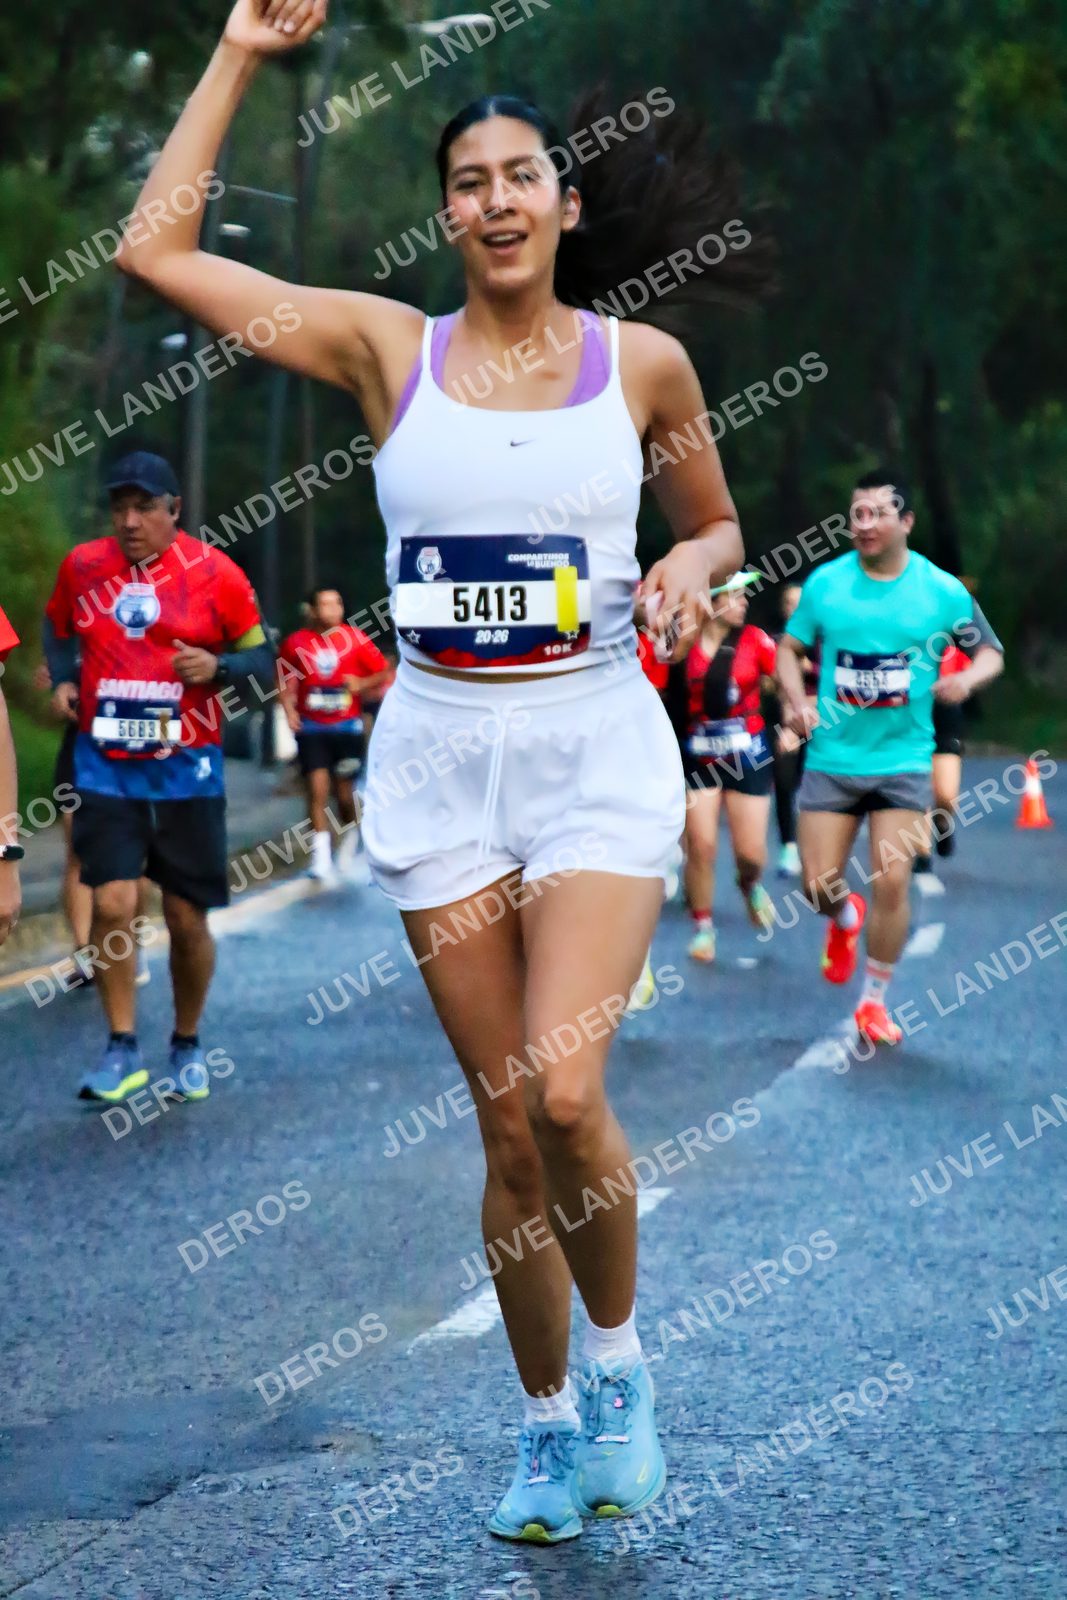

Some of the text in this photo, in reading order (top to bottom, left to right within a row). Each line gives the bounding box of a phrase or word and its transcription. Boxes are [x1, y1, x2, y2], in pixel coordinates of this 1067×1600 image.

[453, 585, 527, 622] 5413
[544, 643, 573, 656] 10K
[95, 677, 184, 700] SANTIAGO
